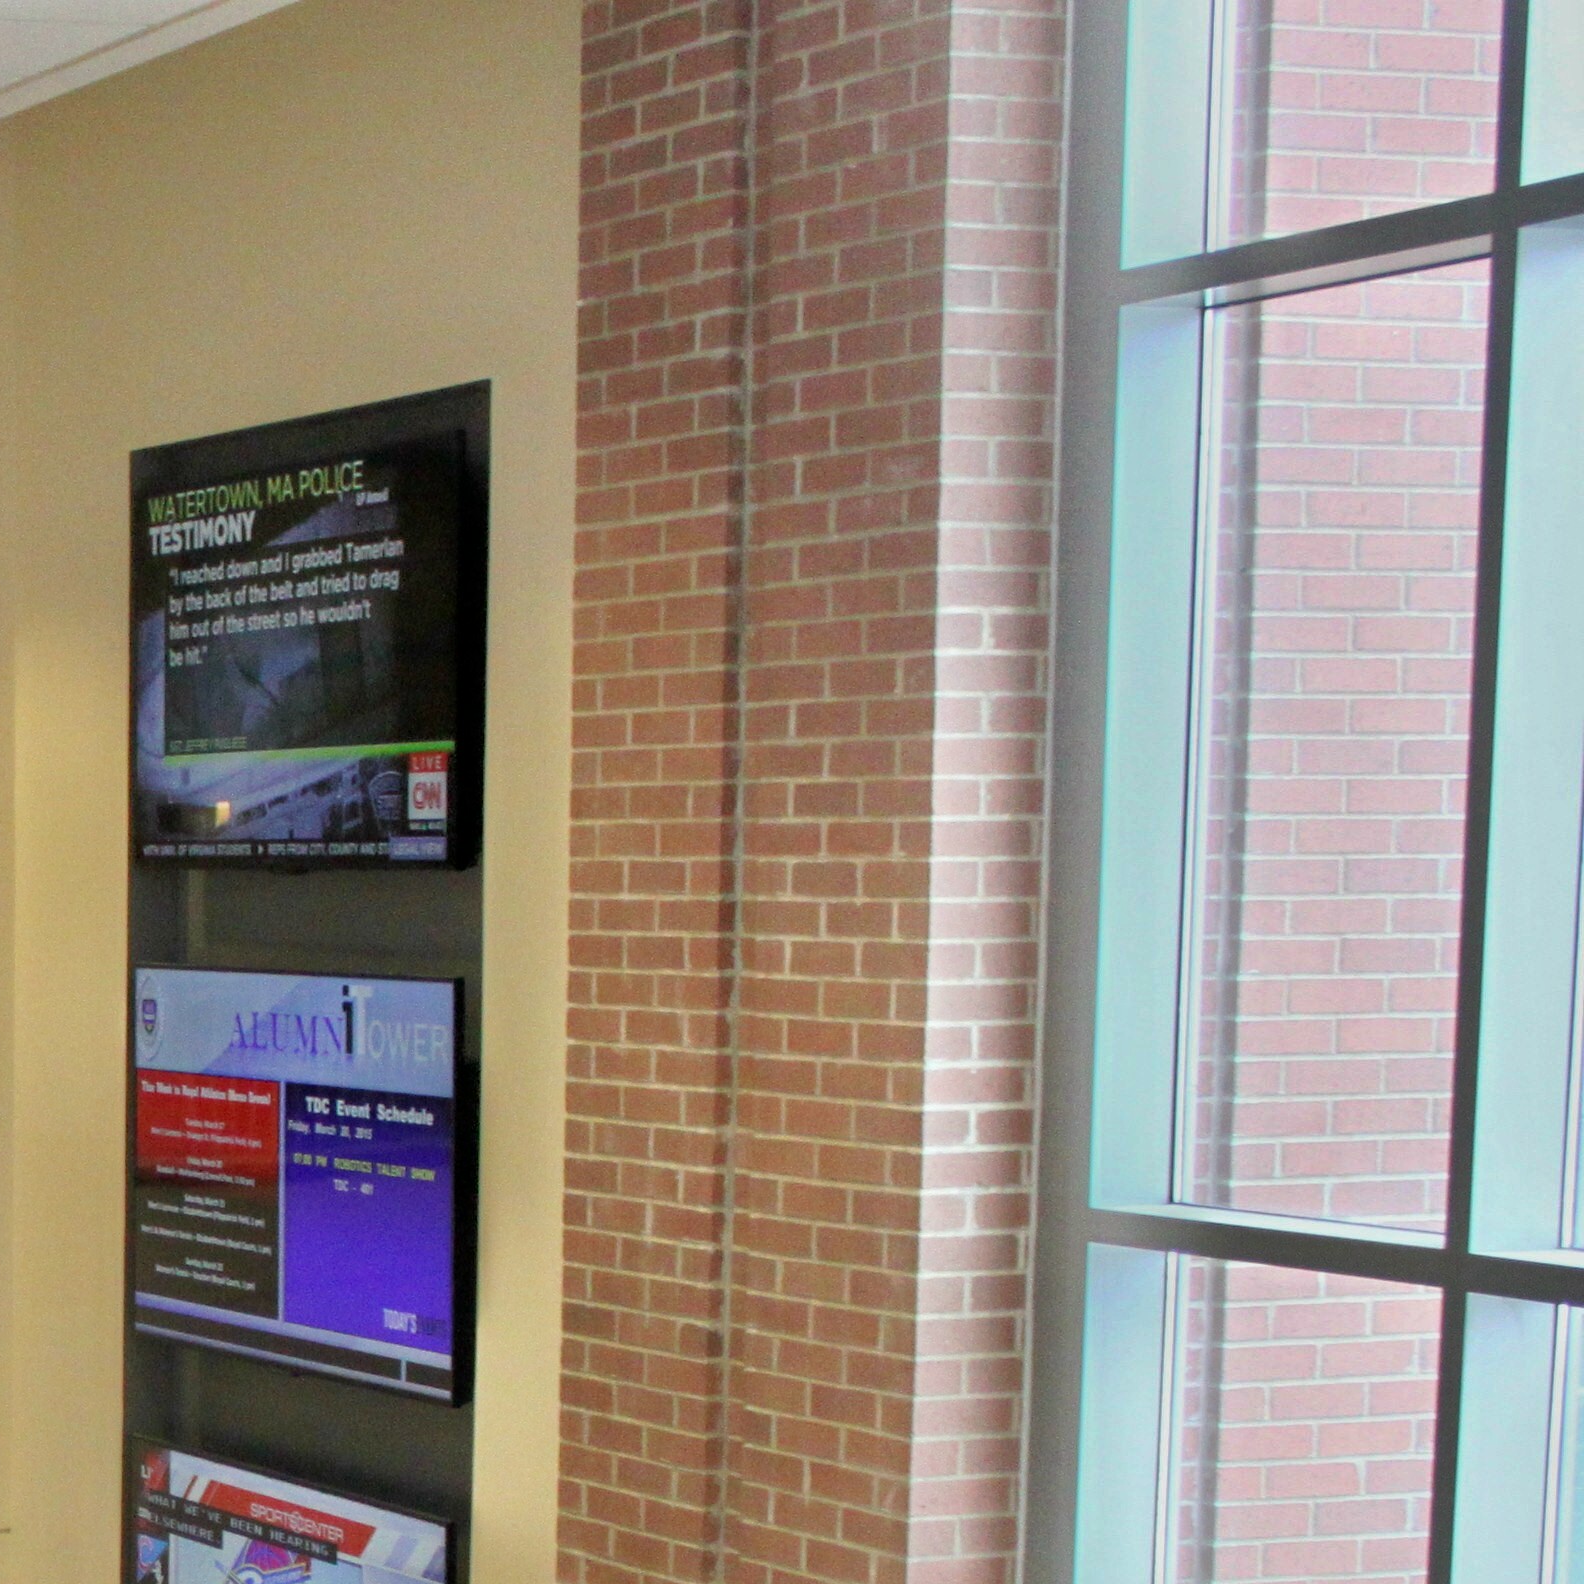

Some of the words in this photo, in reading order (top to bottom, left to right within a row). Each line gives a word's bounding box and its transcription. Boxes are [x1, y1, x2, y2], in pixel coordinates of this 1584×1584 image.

[148, 478, 263, 523] WATERTOWN,
[267, 474, 294, 504] MA
[299, 460, 364, 497] POLICE
[149, 510, 256, 556] TESTIMONY
[180, 561, 224, 583] reached
[228, 559, 258, 579] down
[261, 555, 281, 574] and
[292, 544, 342, 574] grabbed
[346, 538, 404, 562] Tamerlan
[169, 595, 183, 617] by
[186, 593, 203, 612] the
[206, 590, 231, 610] back
[235, 586, 247, 605] of
[249, 584, 268, 603] the
[270, 581, 293, 600] belt
[296, 579, 318, 597] and
[321, 574, 350, 594] tried
[353, 573, 366, 590] to
[370, 569, 399, 593] drag
[169, 622, 189, 640] him
[192, 618, 209, 637] out
[212, 617, 224, 635] of
[227, 615, 245, 634] the
[248, 611, 280, 631] street
[283, 612, 298, 628] so
[301, 608, 315, 627] he
[318, 601, 371, 624] wouldn't
[169, 648, 182, 666] be
[413, 756, 442, 770] LIVE
[305, 1096, 330, 1115] TDC
[336, 1099, 371, 1119] Event
[377, 1103, 434, 1126] Schedule
[230, 1517, 263, 1536] BEEN
